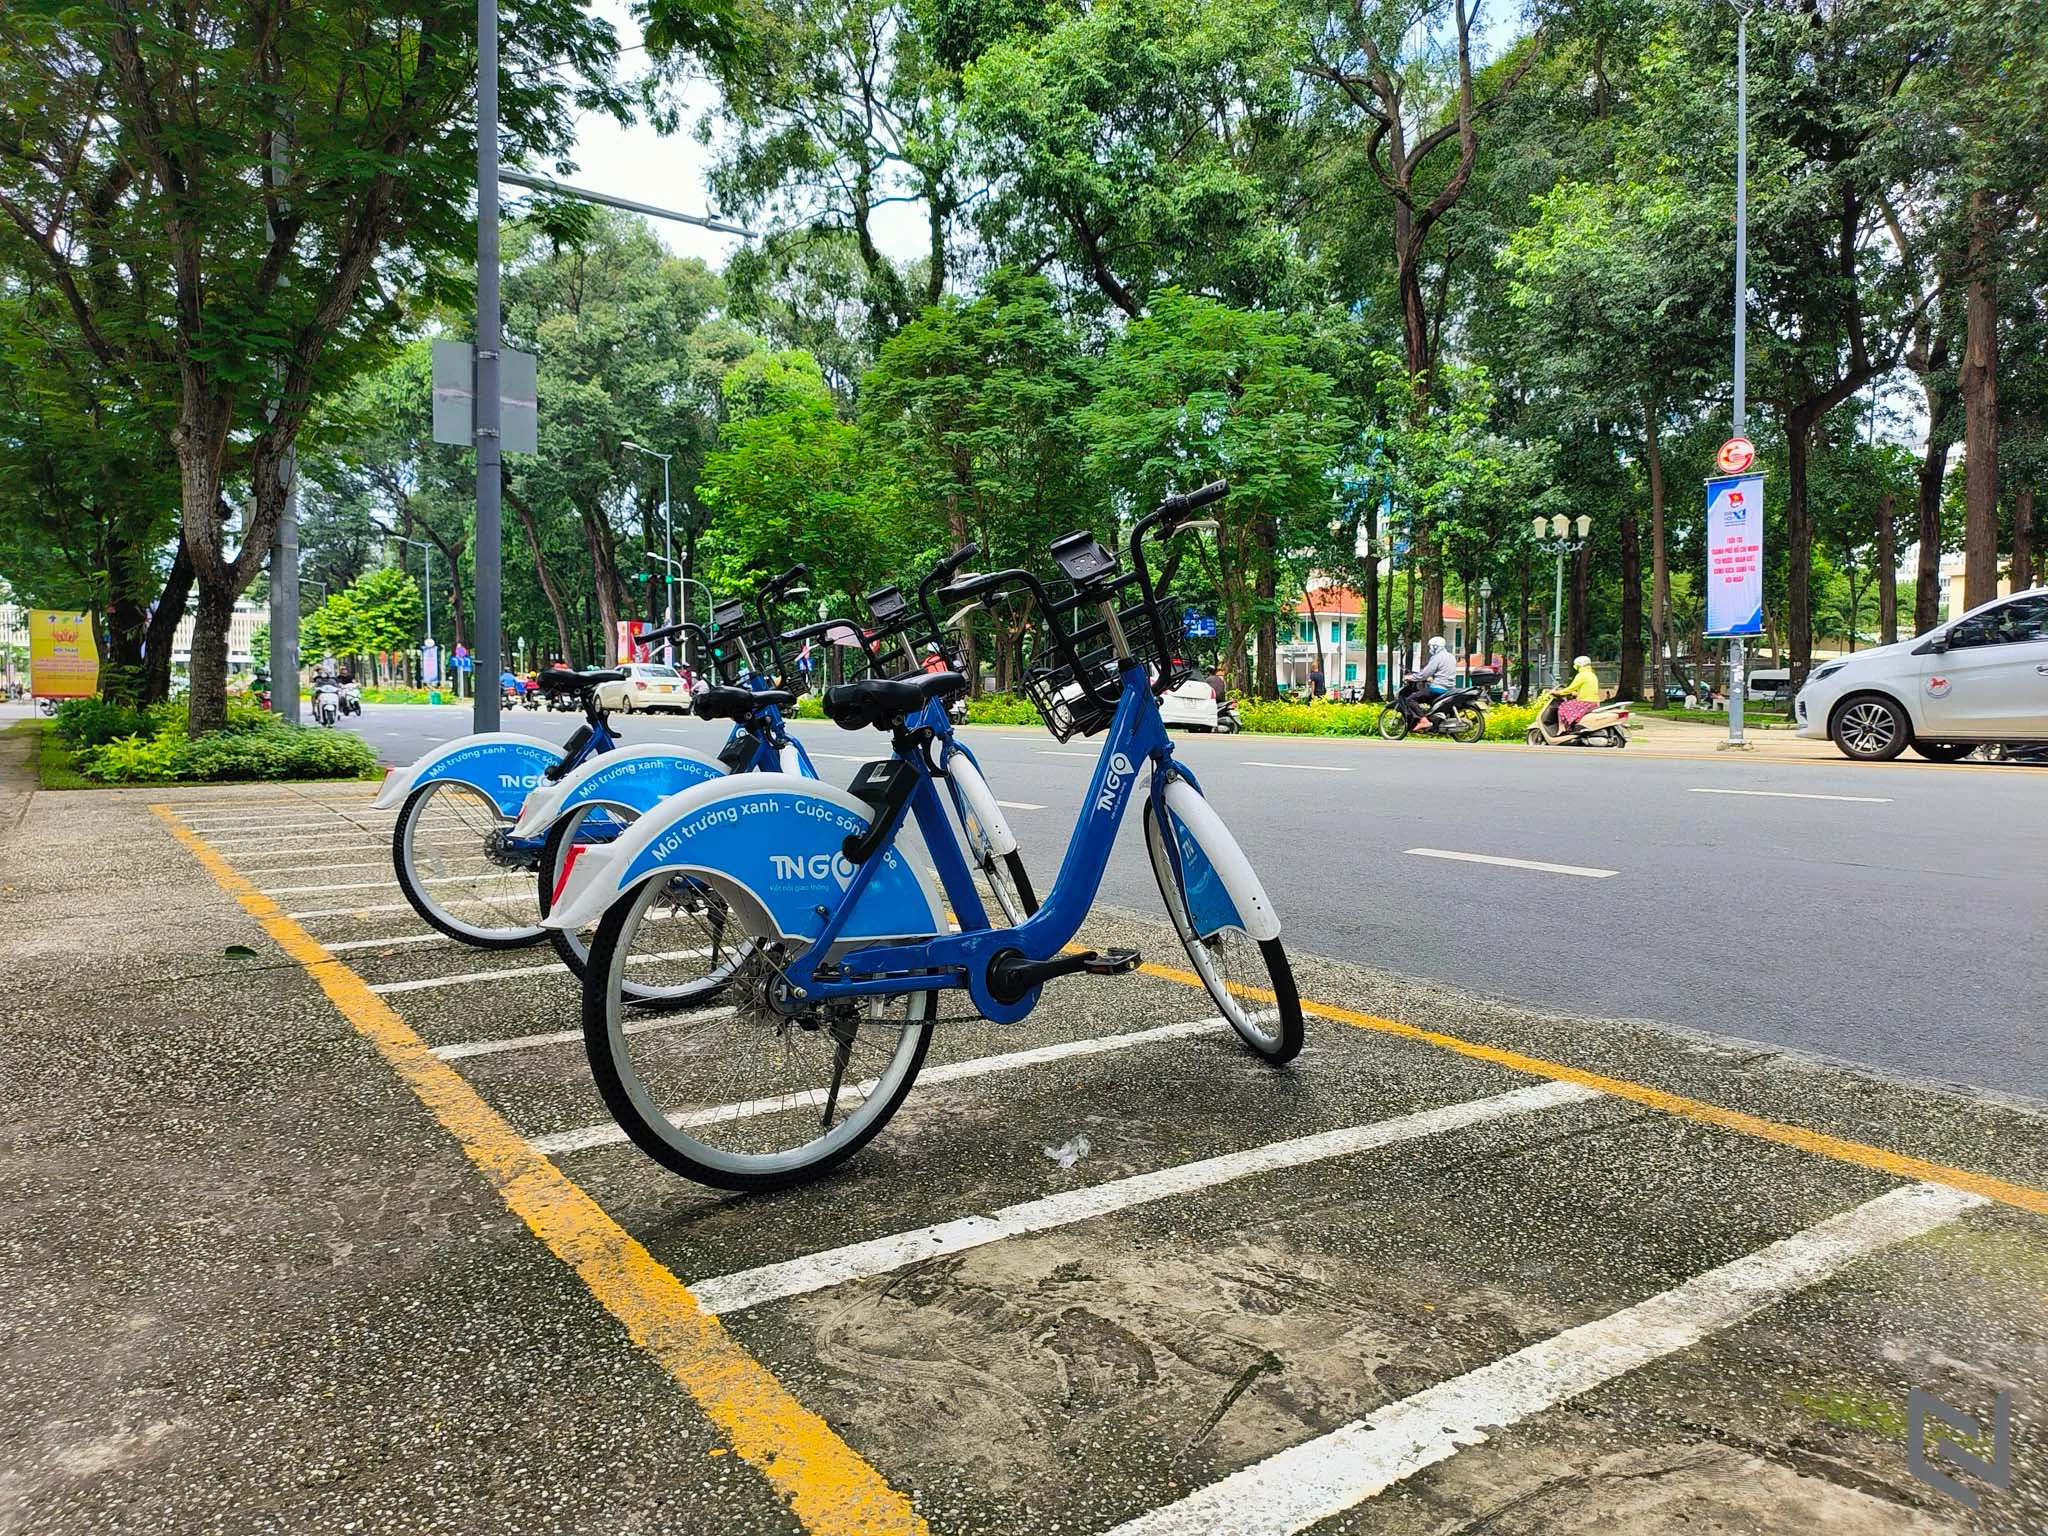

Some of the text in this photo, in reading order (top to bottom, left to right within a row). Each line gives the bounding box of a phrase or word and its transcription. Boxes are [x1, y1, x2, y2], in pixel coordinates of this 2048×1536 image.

[428, 763, 447, 779] Môi
[446, 749, 481, 767] trường
[482, 746, 506, 755] xanh
[515, 747, 541, 759] Cuộc
[541, 754, 560, 767] sốn
[578, 782, 600, 798] Môi
[598, 764, 636, 784] trường
[637, 760, 664, 771] xanh
[674, 760, 702, 775] Cuộc
[650, 832, 684, 862] Môi
[681, 808, 738, 841] trường
[740, 799, 779, 816] xanh
[795, 800, 833, 822] Cuộc
